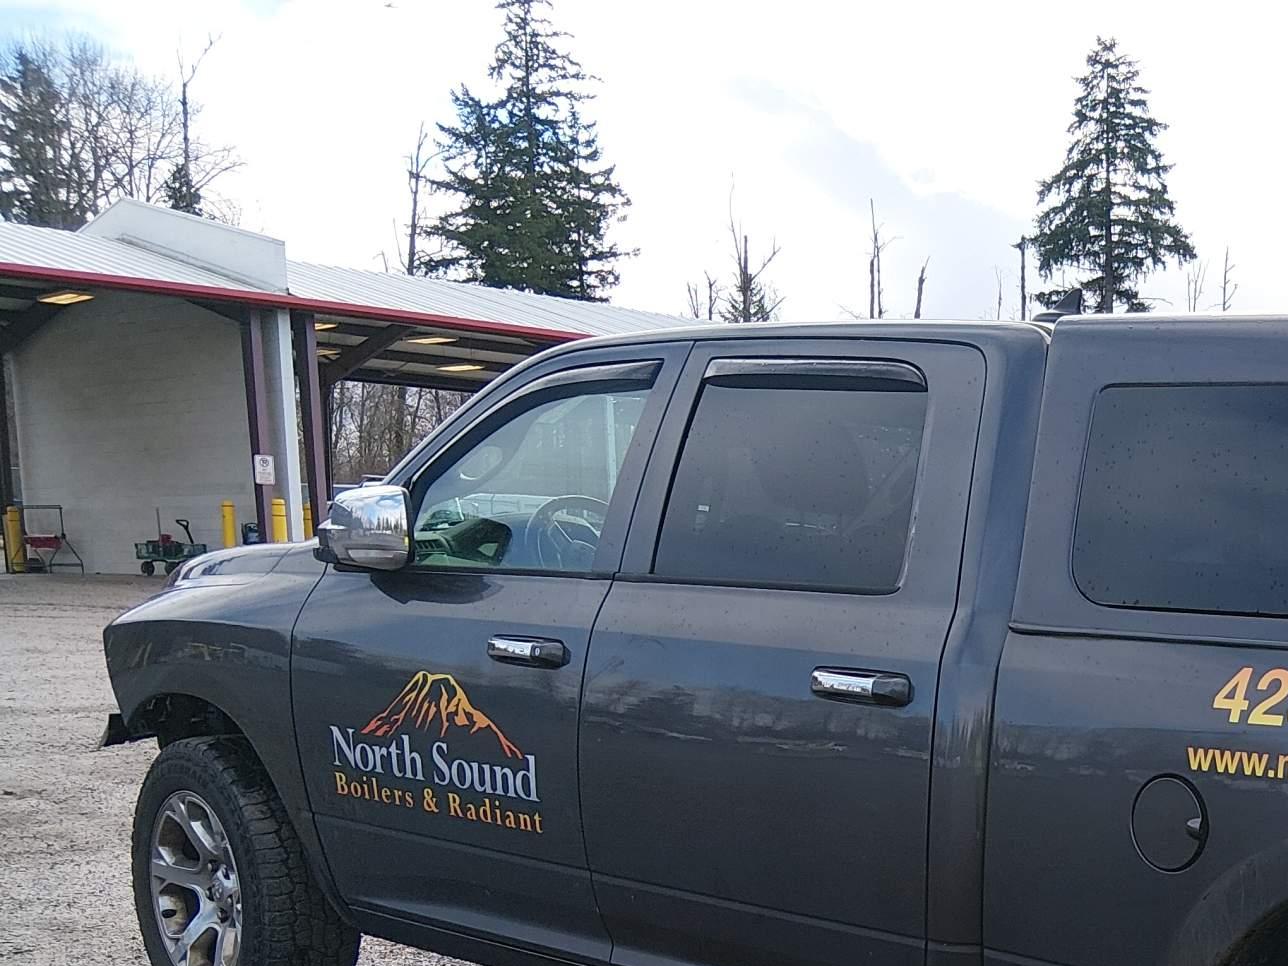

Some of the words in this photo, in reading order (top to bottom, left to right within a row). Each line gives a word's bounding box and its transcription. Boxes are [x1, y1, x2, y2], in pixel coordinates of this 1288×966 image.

[329, 725, 425, 781] North
[432, 741, 541, 802] Sound
[334, 771, 414, 809] Boilers
[423, 787, 440, 813] &
[447, 792, 544, 834] Radiant
